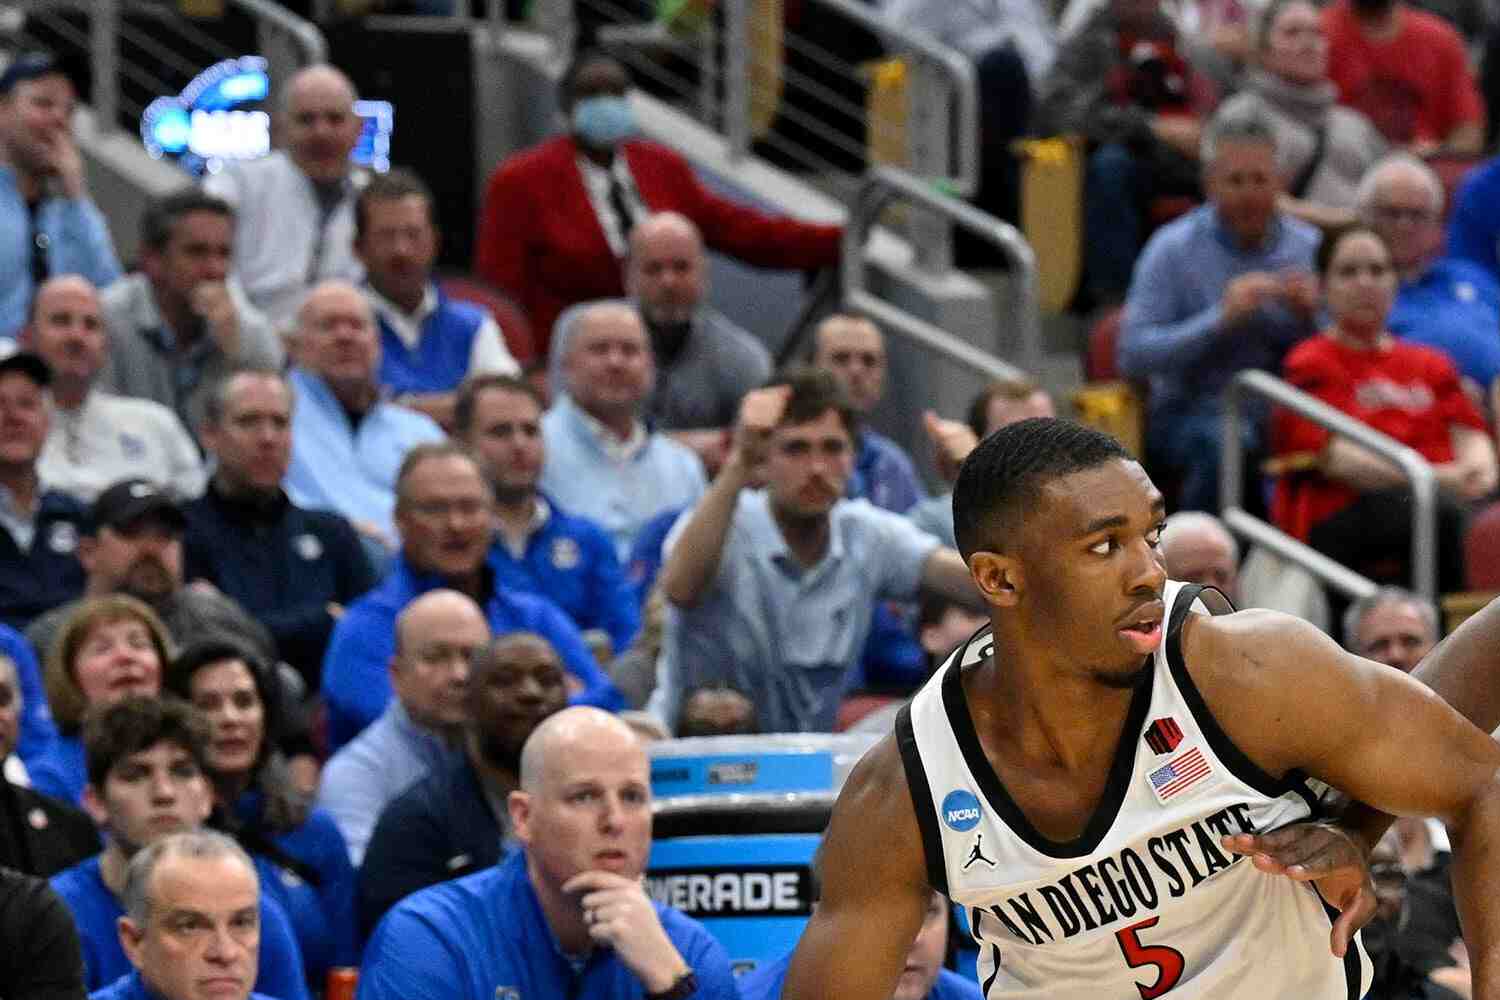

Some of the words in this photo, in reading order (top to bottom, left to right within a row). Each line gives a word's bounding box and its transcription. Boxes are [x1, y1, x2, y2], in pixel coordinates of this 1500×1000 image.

[948, 808, 979, 822] NCAA
[1040, 847, 1159, 938] DIEGO
[1115, 915, 1186, 1000] 5
